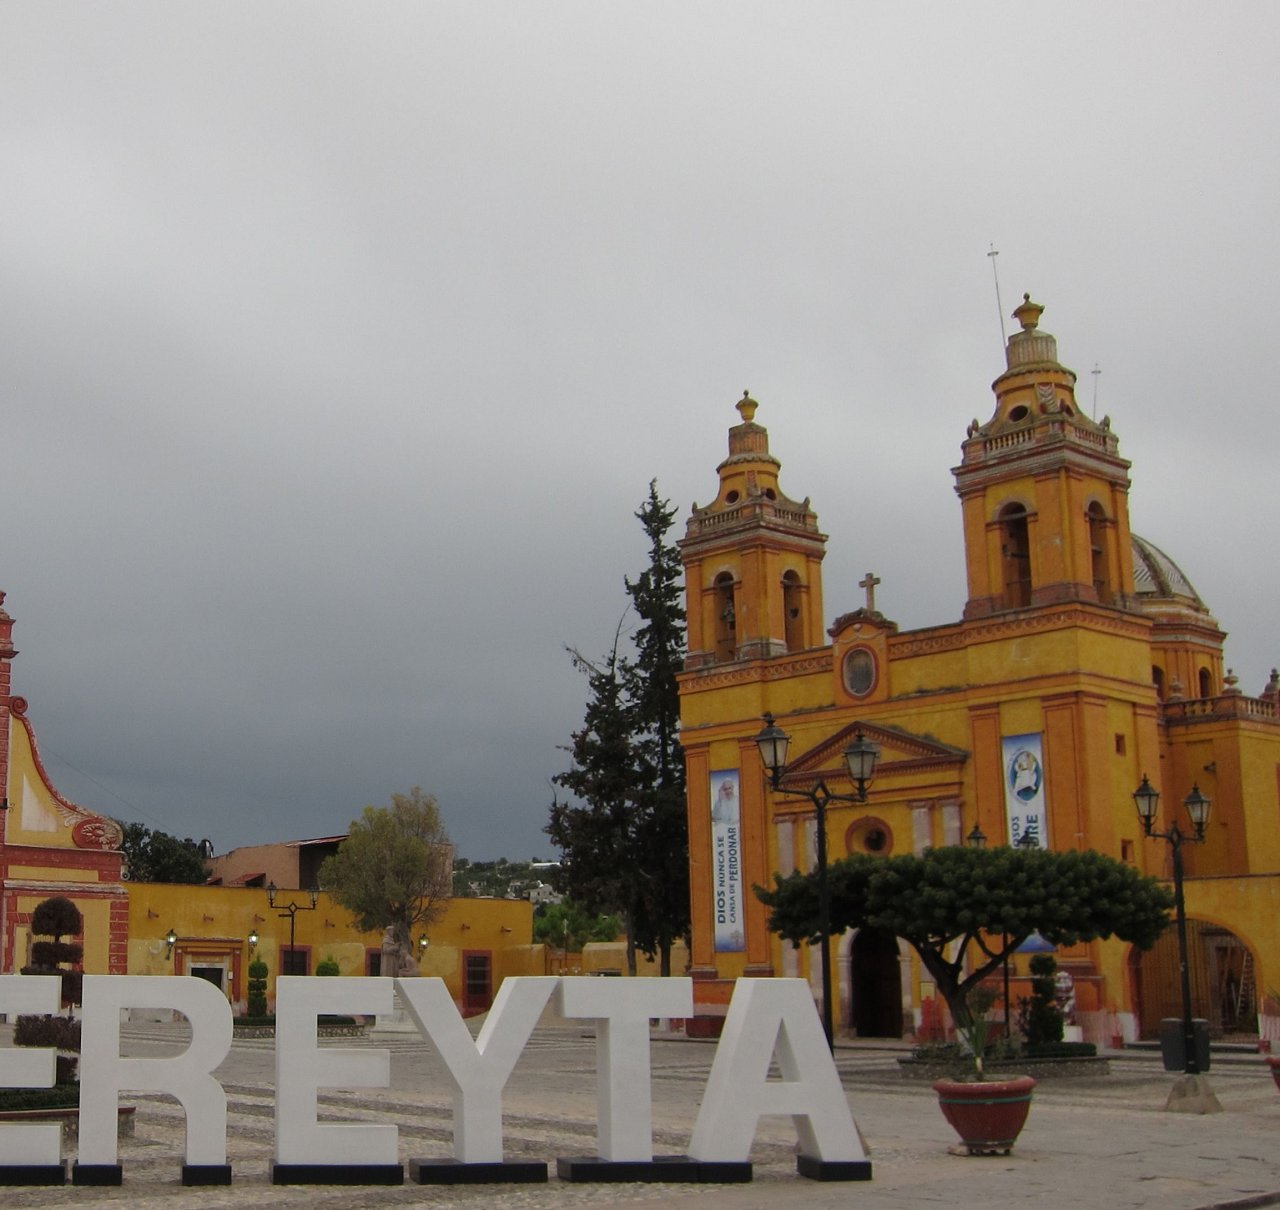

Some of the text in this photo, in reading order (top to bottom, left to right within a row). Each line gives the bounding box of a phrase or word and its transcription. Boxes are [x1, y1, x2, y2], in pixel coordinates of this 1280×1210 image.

[717, 836, 724, 848] SE
[728, 827, 738, 881] PERDONAR
[717, 890, 726, 924] DIOS
